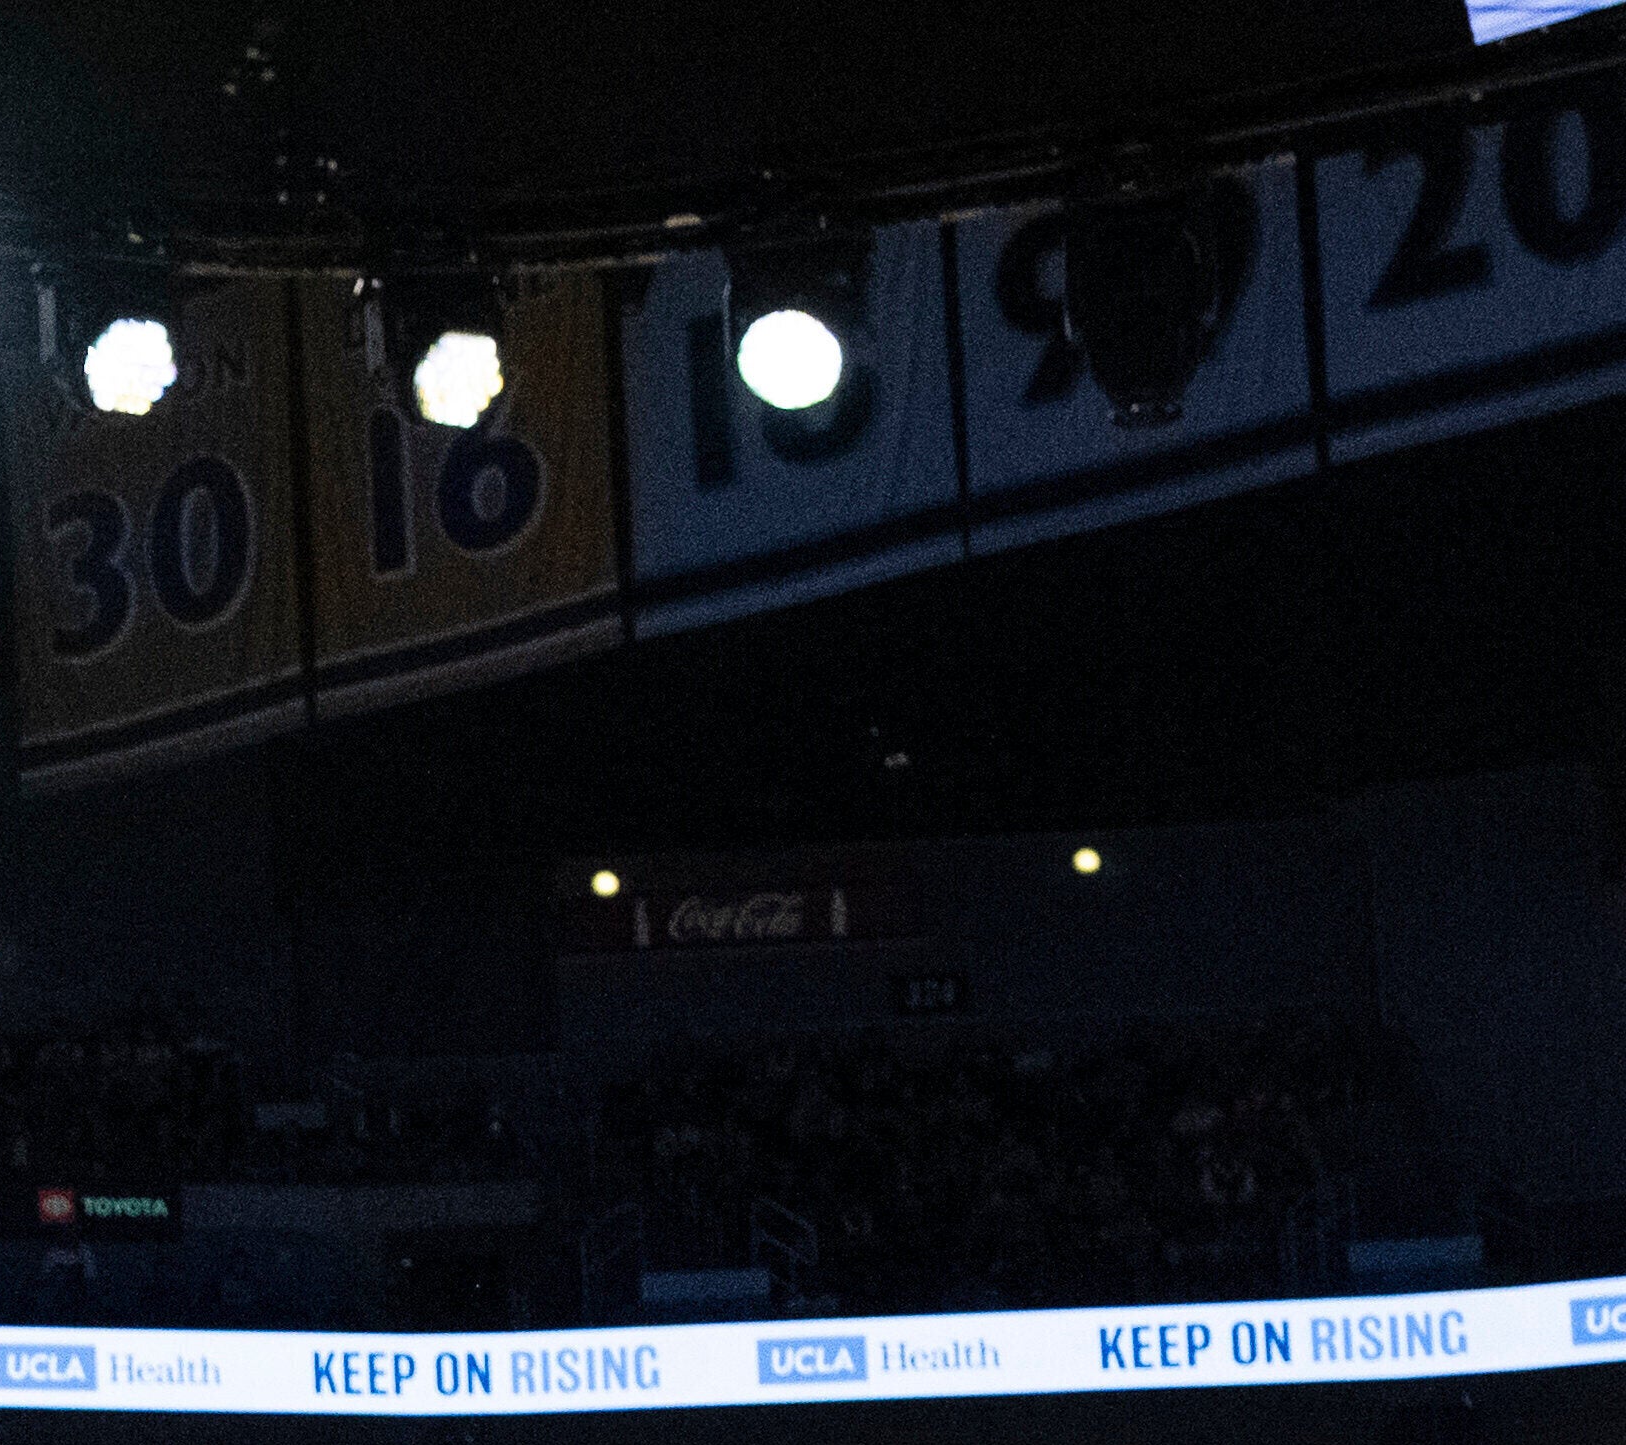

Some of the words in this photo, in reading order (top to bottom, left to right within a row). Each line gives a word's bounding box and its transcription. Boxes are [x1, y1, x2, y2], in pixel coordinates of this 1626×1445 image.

[366, 405, 547, 583] 16
[44, 455, 257, 665] 30
[82, 1196, 169, 1220] TOYOTA
[1098, 1322, 1213, 1371] KEEP
[1230, 1319, 1292, 1367] ON
[1310, 1309, 1468, 1362] RISING
[1586, 1304, 1626, 1334] UC
[5, 1352, 86, 1382] UCLA
[109, 1353, 222, 1386] Health
[312, 1351, 417, 1397] KEEP
[434, 1351, 493, 1397] ON
[511, 1345, 660, 1394] RISING
[772, 1347, 853, 1376] UCLA
[880, 1339, 1002, 1374] Health
